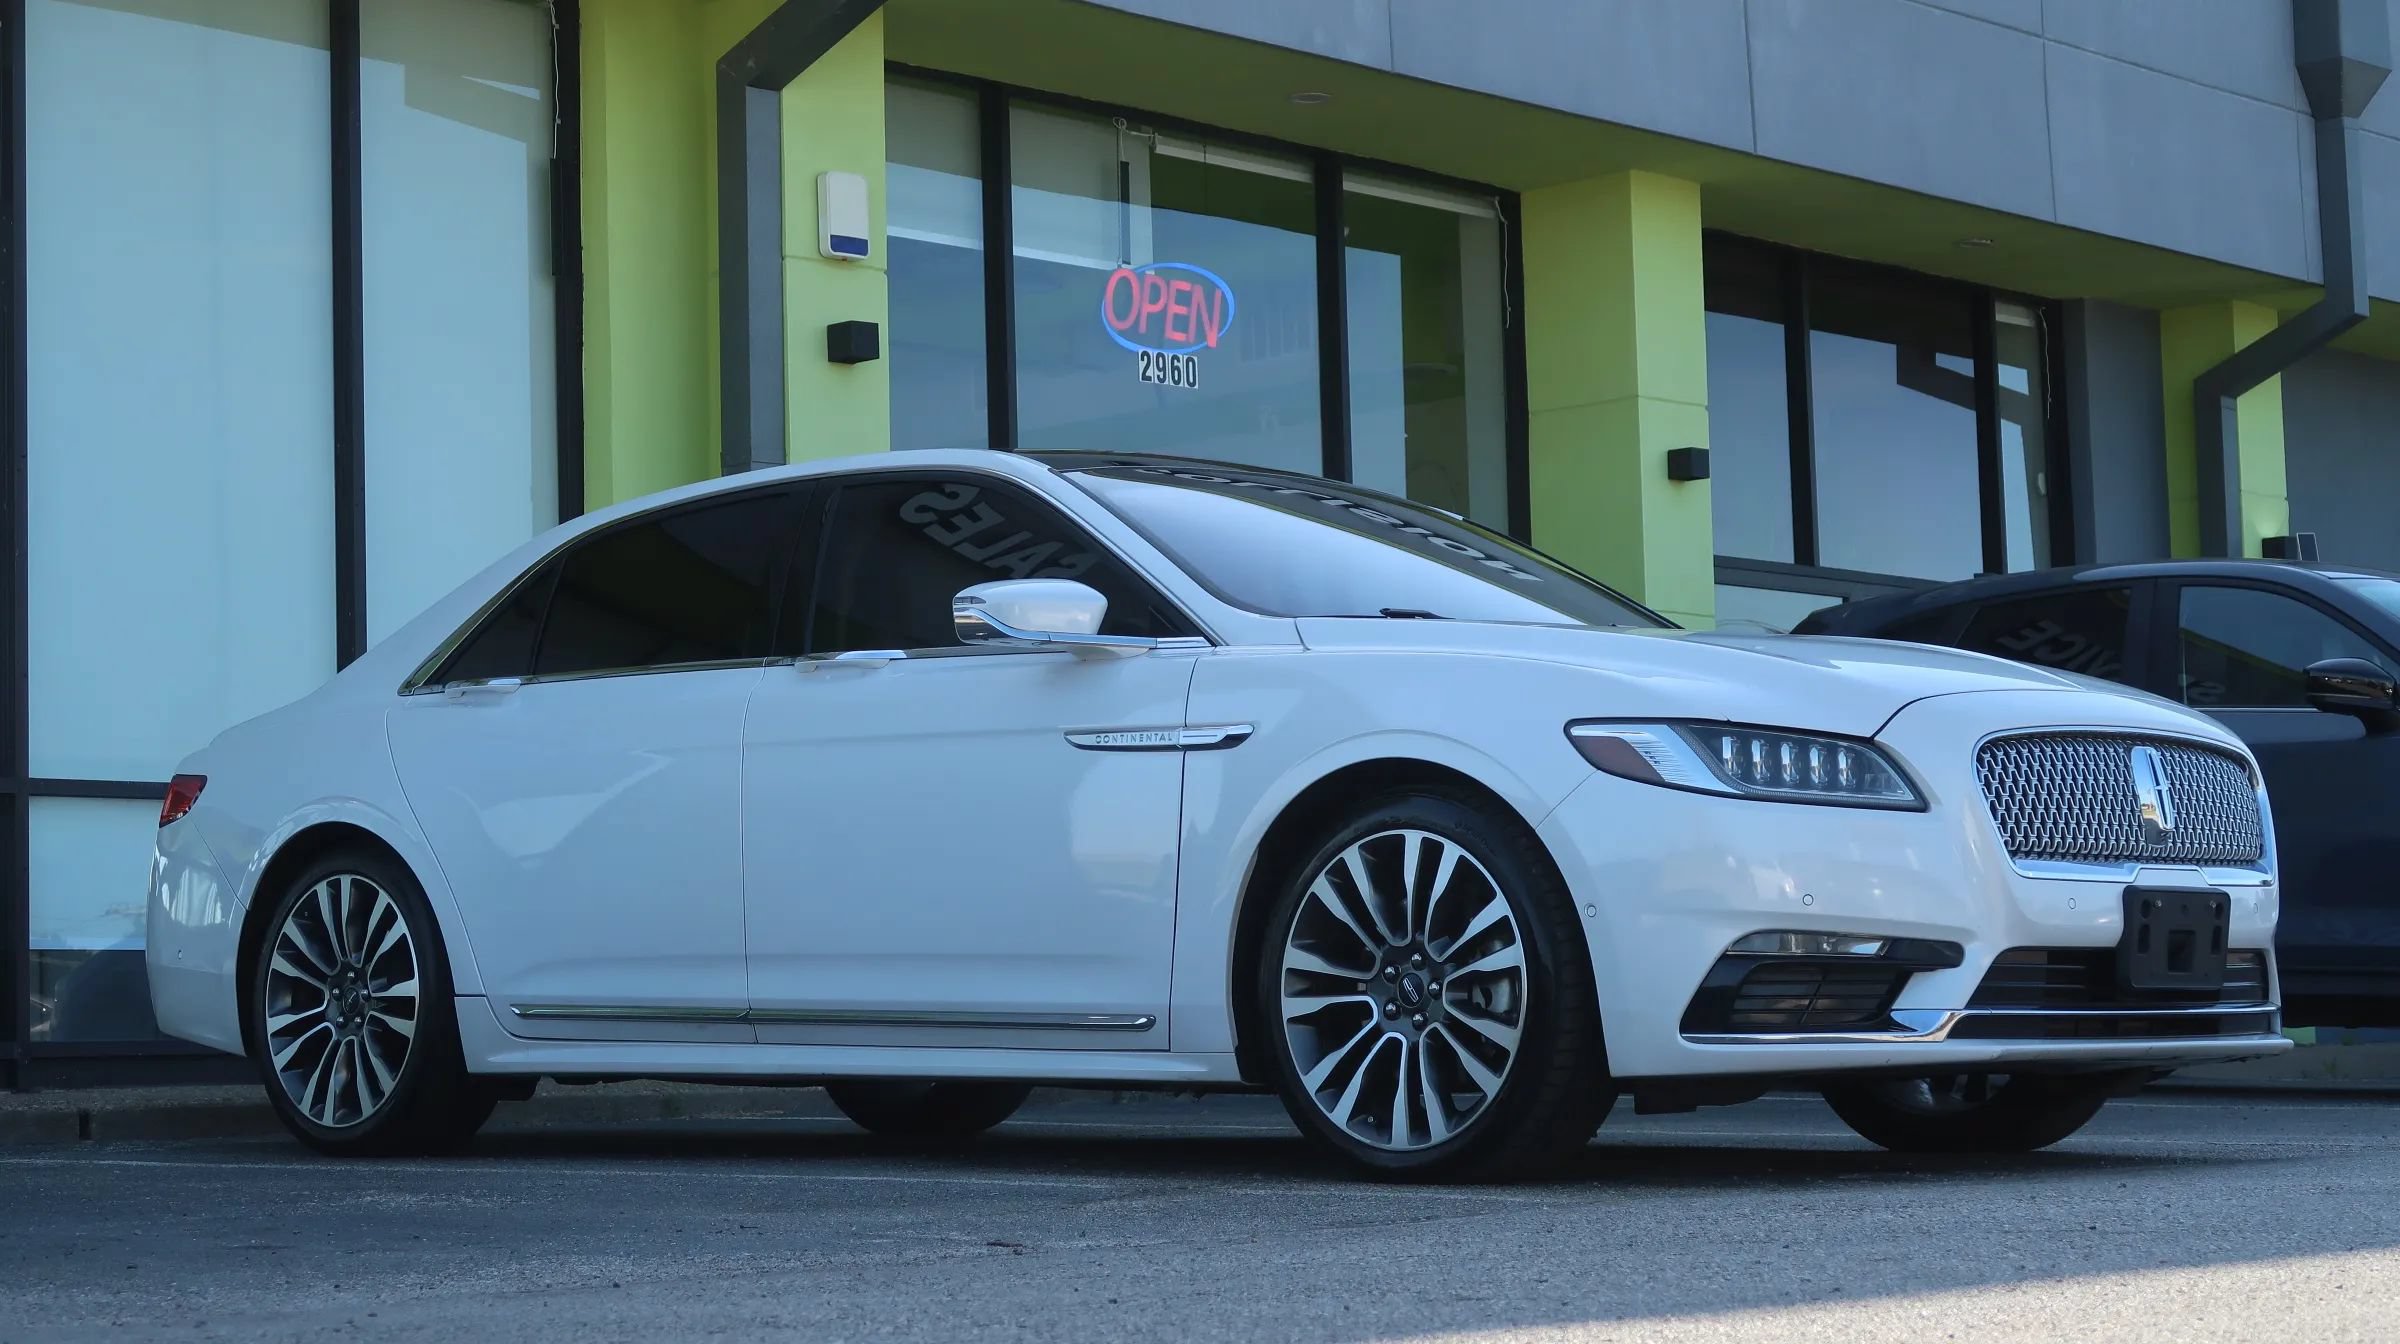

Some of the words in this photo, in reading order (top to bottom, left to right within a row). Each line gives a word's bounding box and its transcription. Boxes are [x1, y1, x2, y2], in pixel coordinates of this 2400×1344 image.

[1104, 268, 1222, 349] OPEN
[1140, 350, 1198, 388] 2960
[1095, 732, 1173, 745] CONTINENTAL
